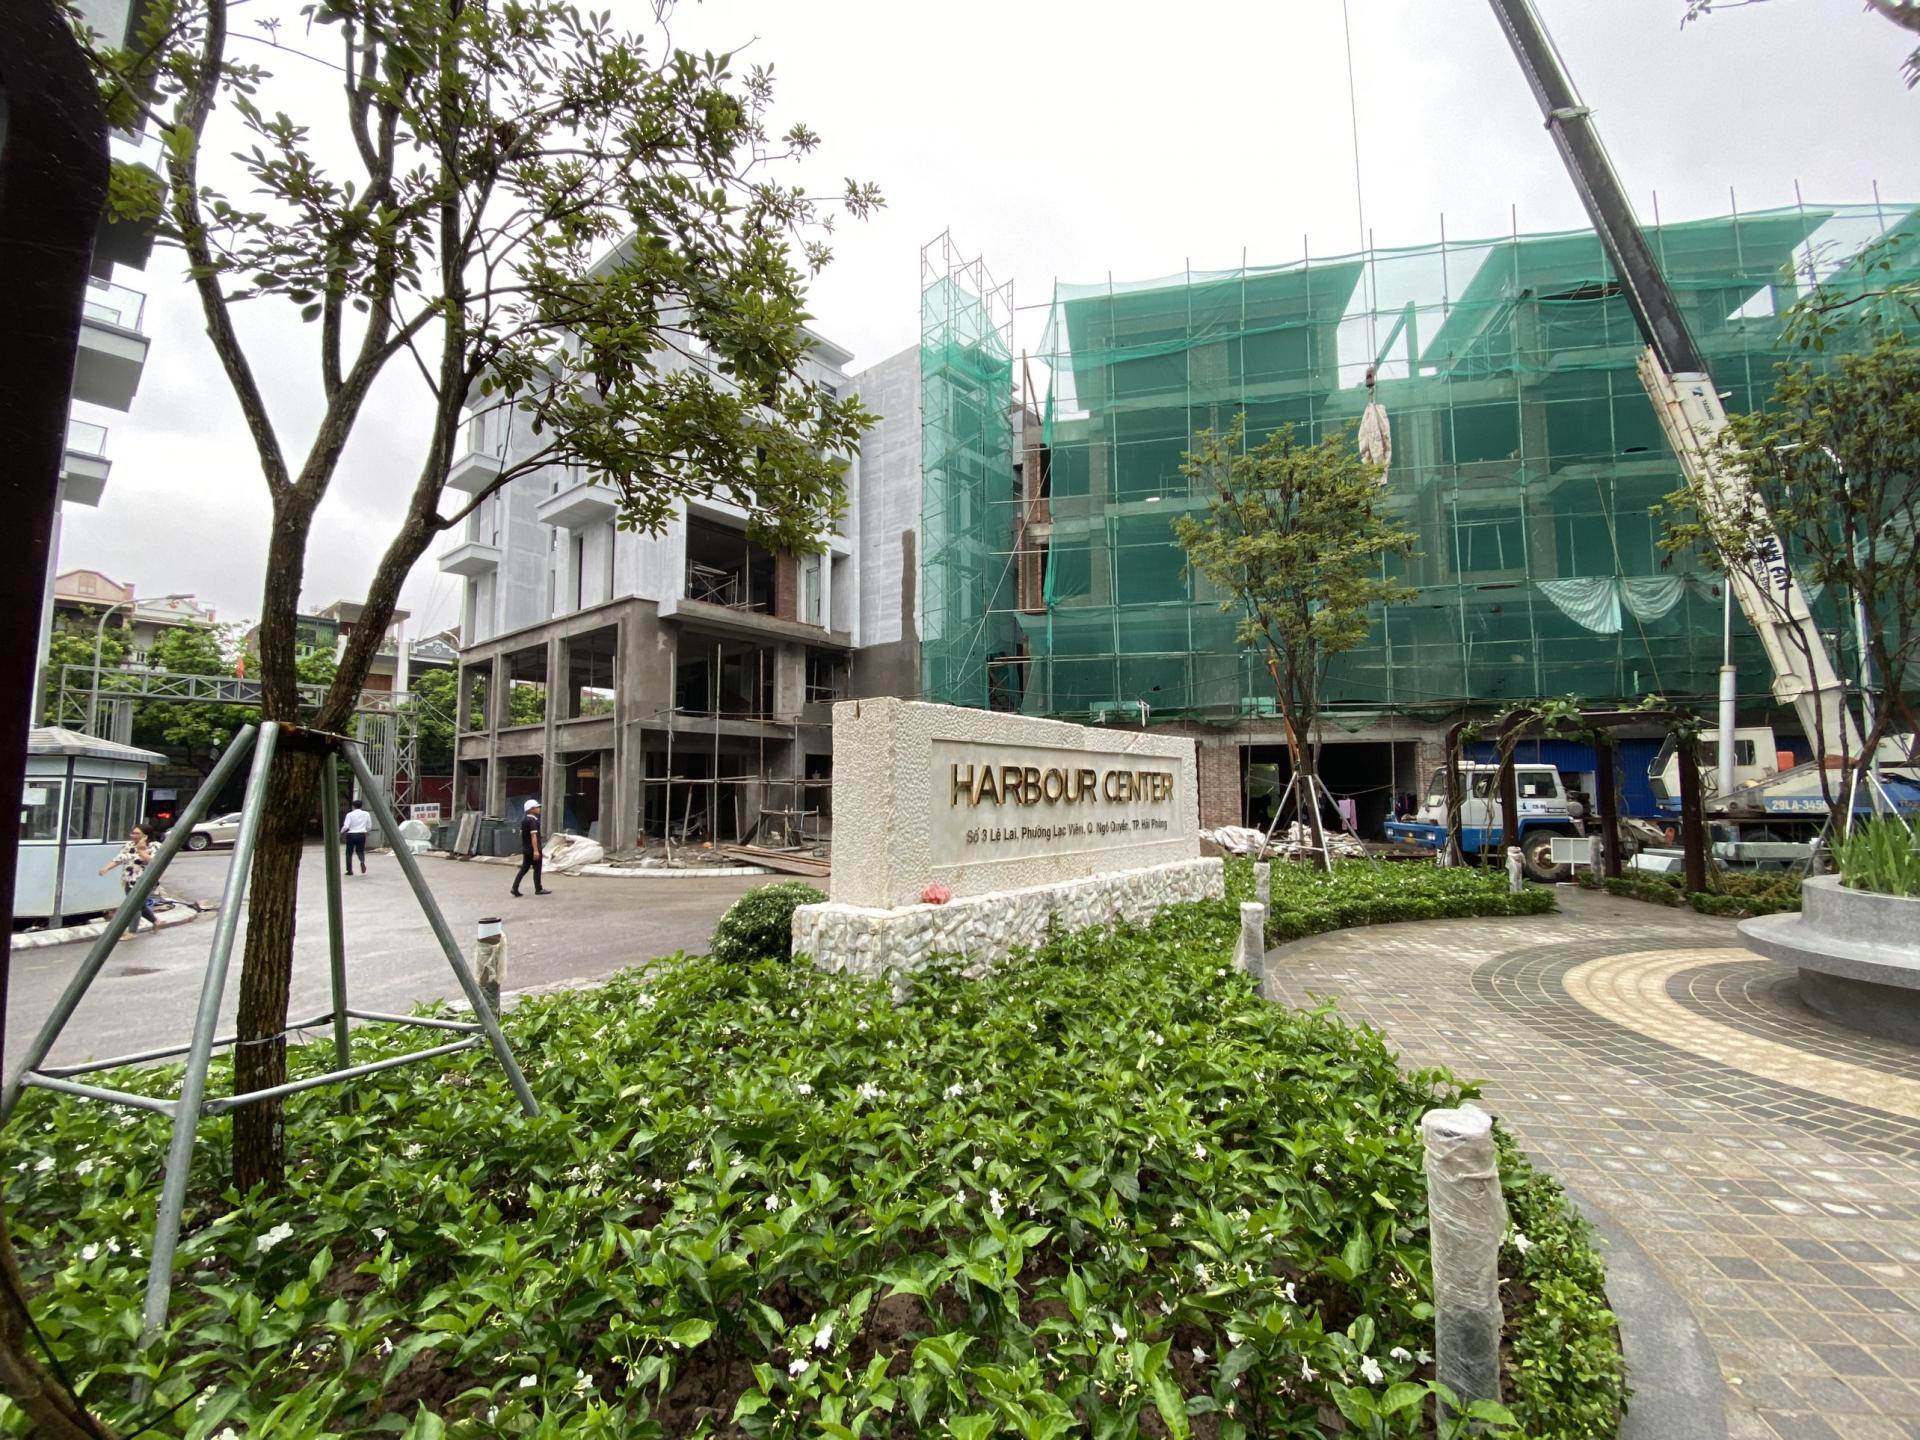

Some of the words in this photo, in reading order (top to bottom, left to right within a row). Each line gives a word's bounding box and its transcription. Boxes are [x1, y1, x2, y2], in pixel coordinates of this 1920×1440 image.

[951, 763, 1097, 808] HARBOUR
[1101, 769, 1174, 805] CENTER
[966, 827, 980, 843] Số
[982, 829, 988, 841] 3
[990, 828, 1001, 841] Lê
[1096, 821, 1109, 836] Ngô
